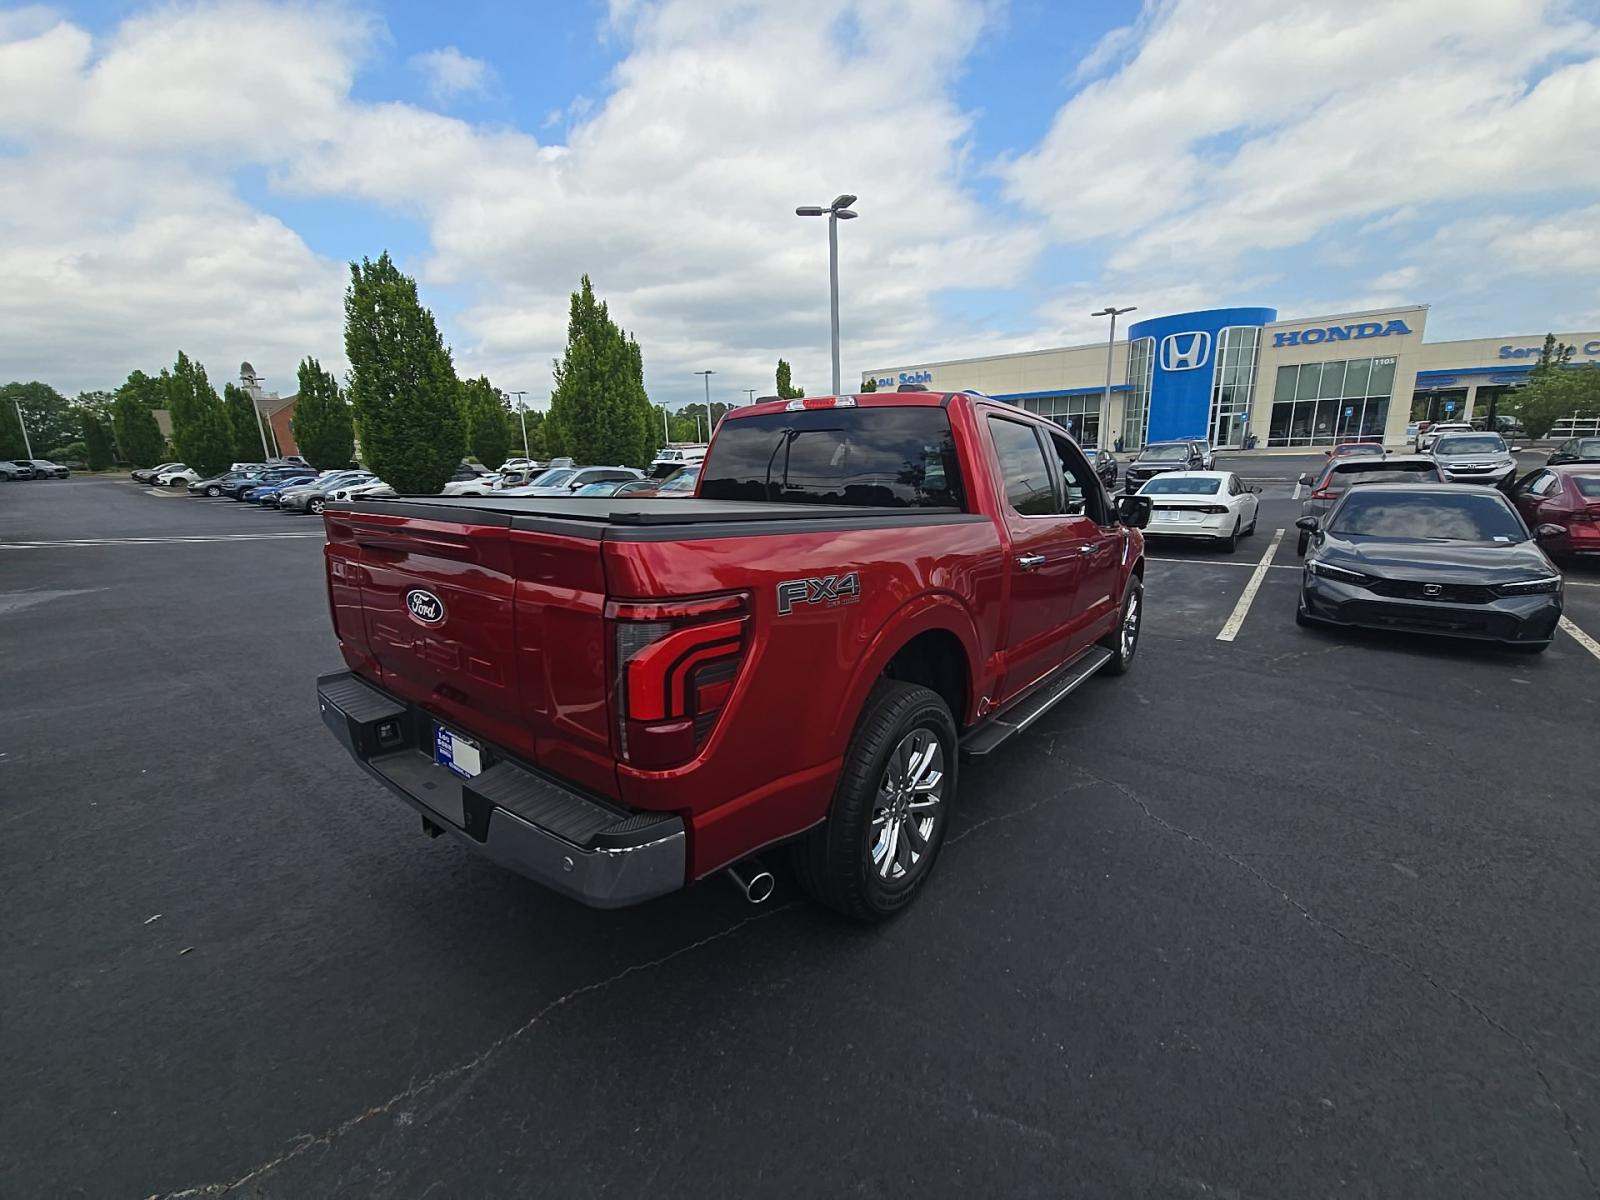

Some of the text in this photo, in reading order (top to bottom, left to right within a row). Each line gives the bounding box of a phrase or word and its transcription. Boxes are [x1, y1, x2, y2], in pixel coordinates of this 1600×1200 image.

[1273, 319, 1412, 347] HONDA
[412, 593, 435, 618] Ford
[776, 571, 860, 616] FX4
